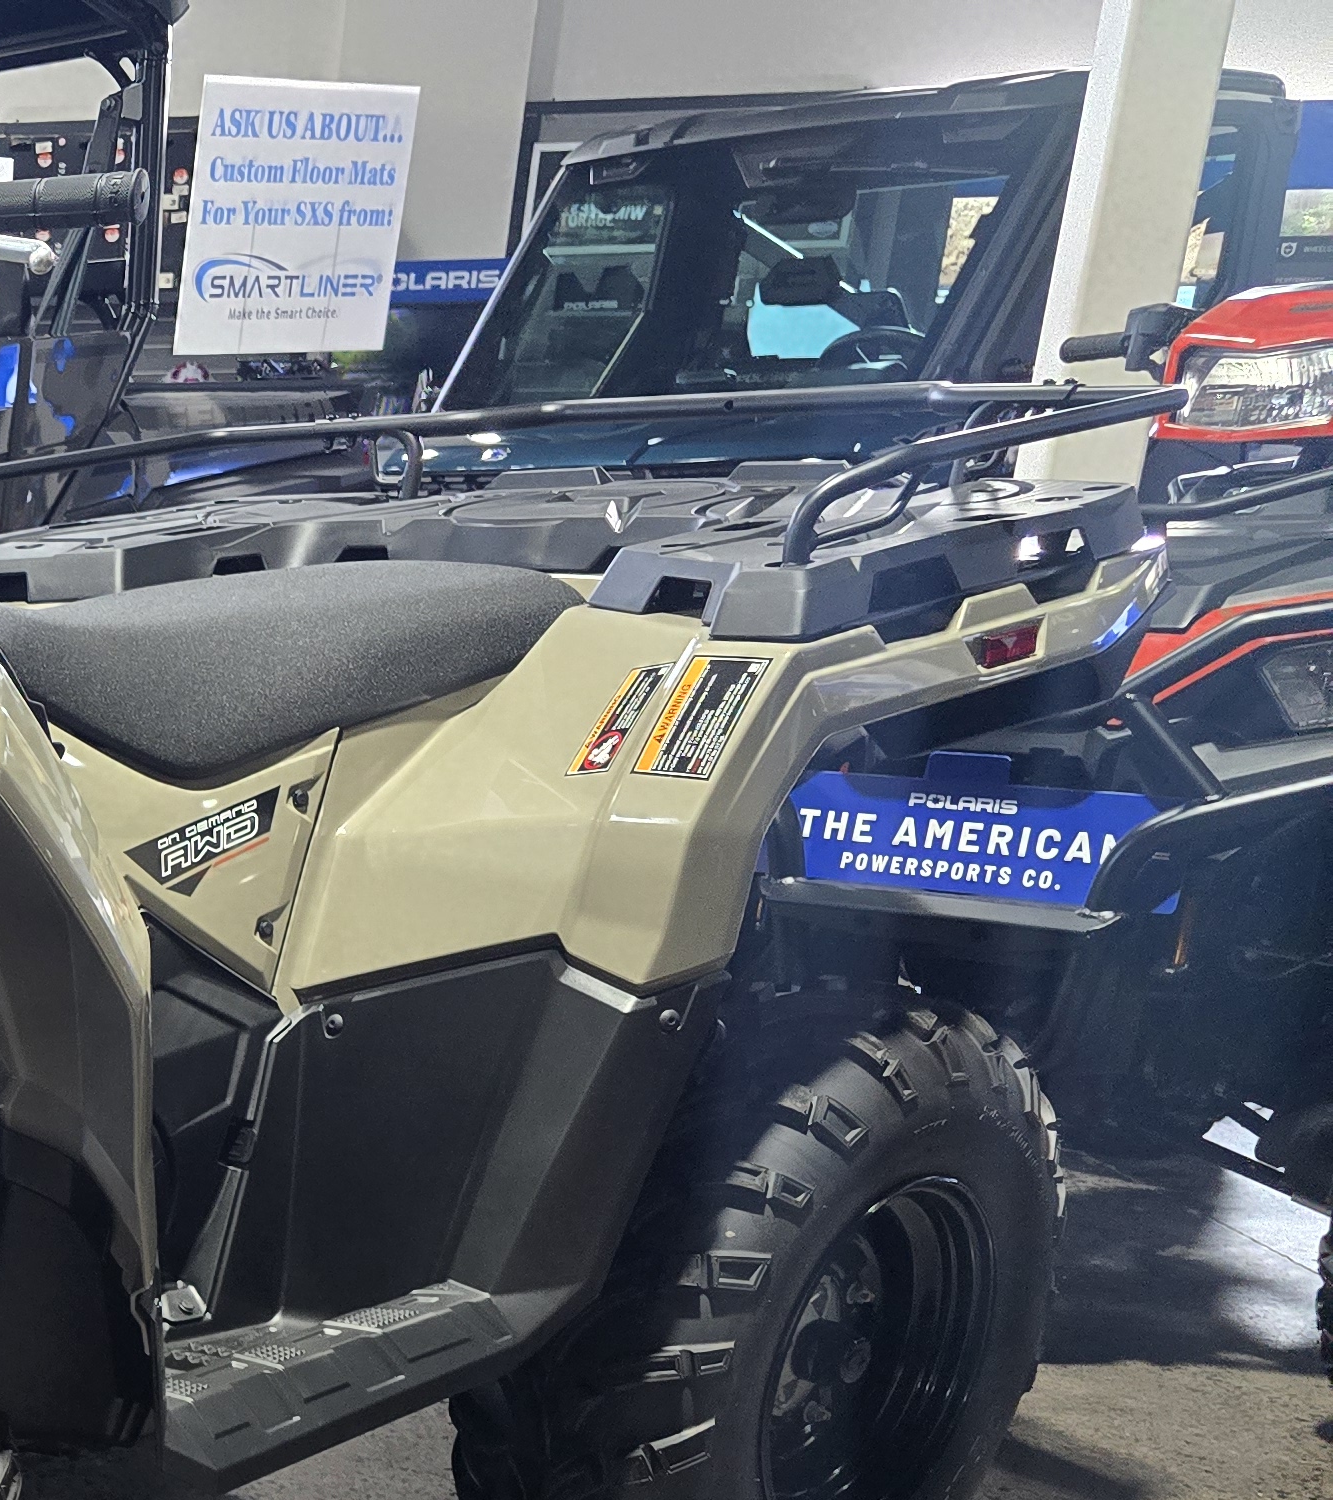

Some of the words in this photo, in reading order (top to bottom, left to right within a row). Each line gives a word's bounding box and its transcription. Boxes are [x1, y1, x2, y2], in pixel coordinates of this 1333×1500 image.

[211, 107, 262, 139] ASK
[267, 110, 298, 140] US
[301, 112, 403, 144] ABOUT...
[210, 156, 284, 183] Custom
[289, 157, 345, 185] Floor
[347, 160, 397, 187] Mats
[200, 199, 237, 225] For
[241, 200, 291, 226] Your
[294, 201, 334, 227] SXS
[391, 269, 502, 292] OLARIS
[228, 307, 254, 320] Make
[255, 307, 272, 320] the
[274, 307, 304, 320] Smart
[660, 683, 692, 735] WARNING
[908, 792, 1018, 815] POLARIS
[799, 807, 877, 843] THE
[161, 812, 259, 878] AWD
[839, 851, 1012, 885] POWERSPORTS
[1022, 870, 1061, 890] CO.
